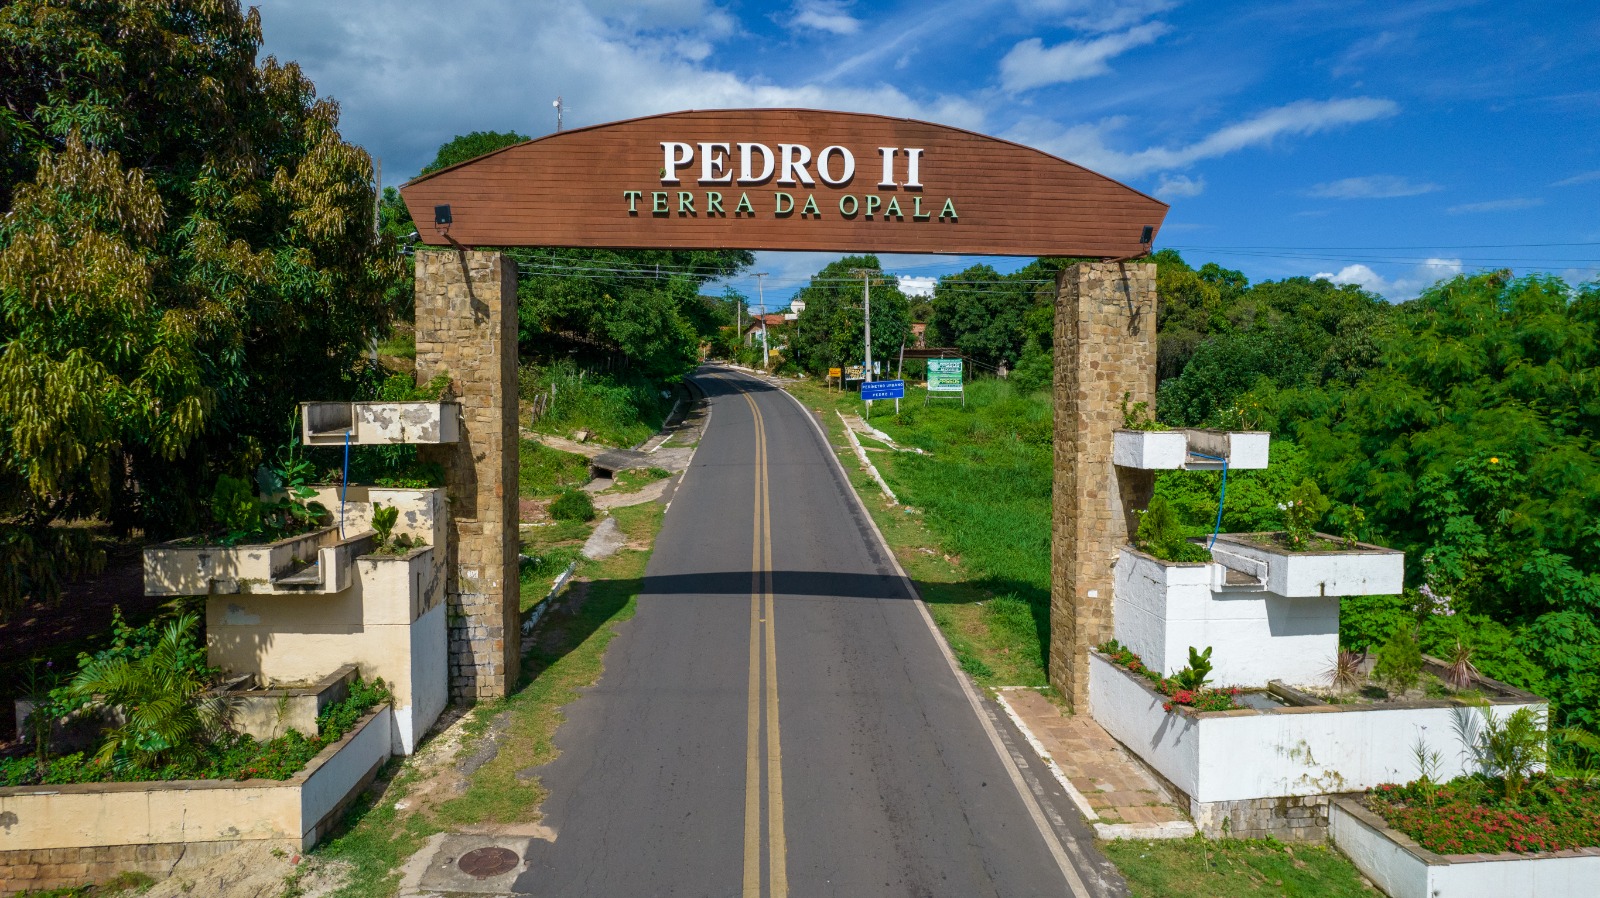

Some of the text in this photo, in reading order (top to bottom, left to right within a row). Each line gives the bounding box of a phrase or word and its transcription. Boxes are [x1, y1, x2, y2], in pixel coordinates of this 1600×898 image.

[660, 141, 924, 190] PEDRO II
[624, 191, 959, 220] TERRA DA OPALA
